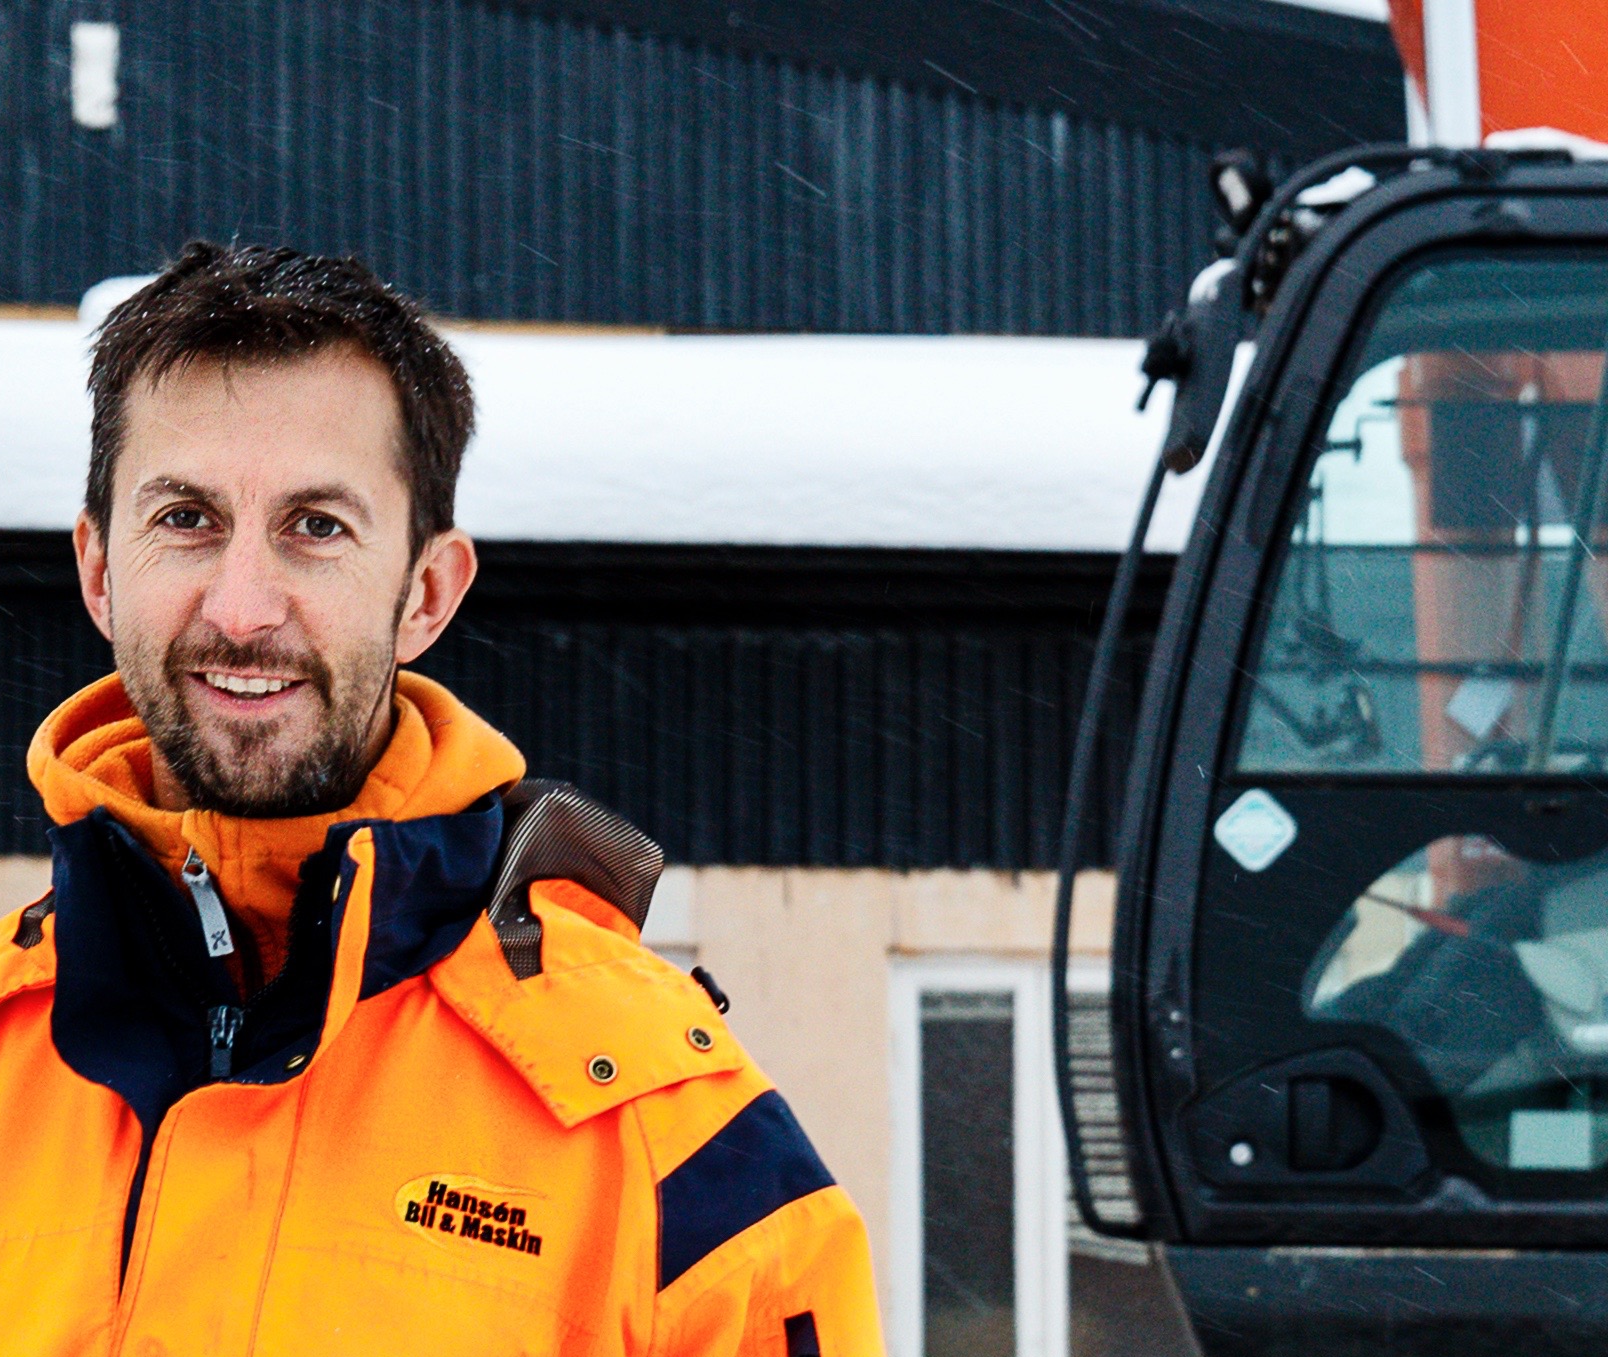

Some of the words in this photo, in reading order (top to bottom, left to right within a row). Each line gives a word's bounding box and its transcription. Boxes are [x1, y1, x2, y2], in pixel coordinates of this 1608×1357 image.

[405, 1200, 437, 1228] Bil
[439, 1213, 456, 1234] &
[459, 1215, 543, 1256] Maskin
[426, 1180, 527, 1226] Hansén
